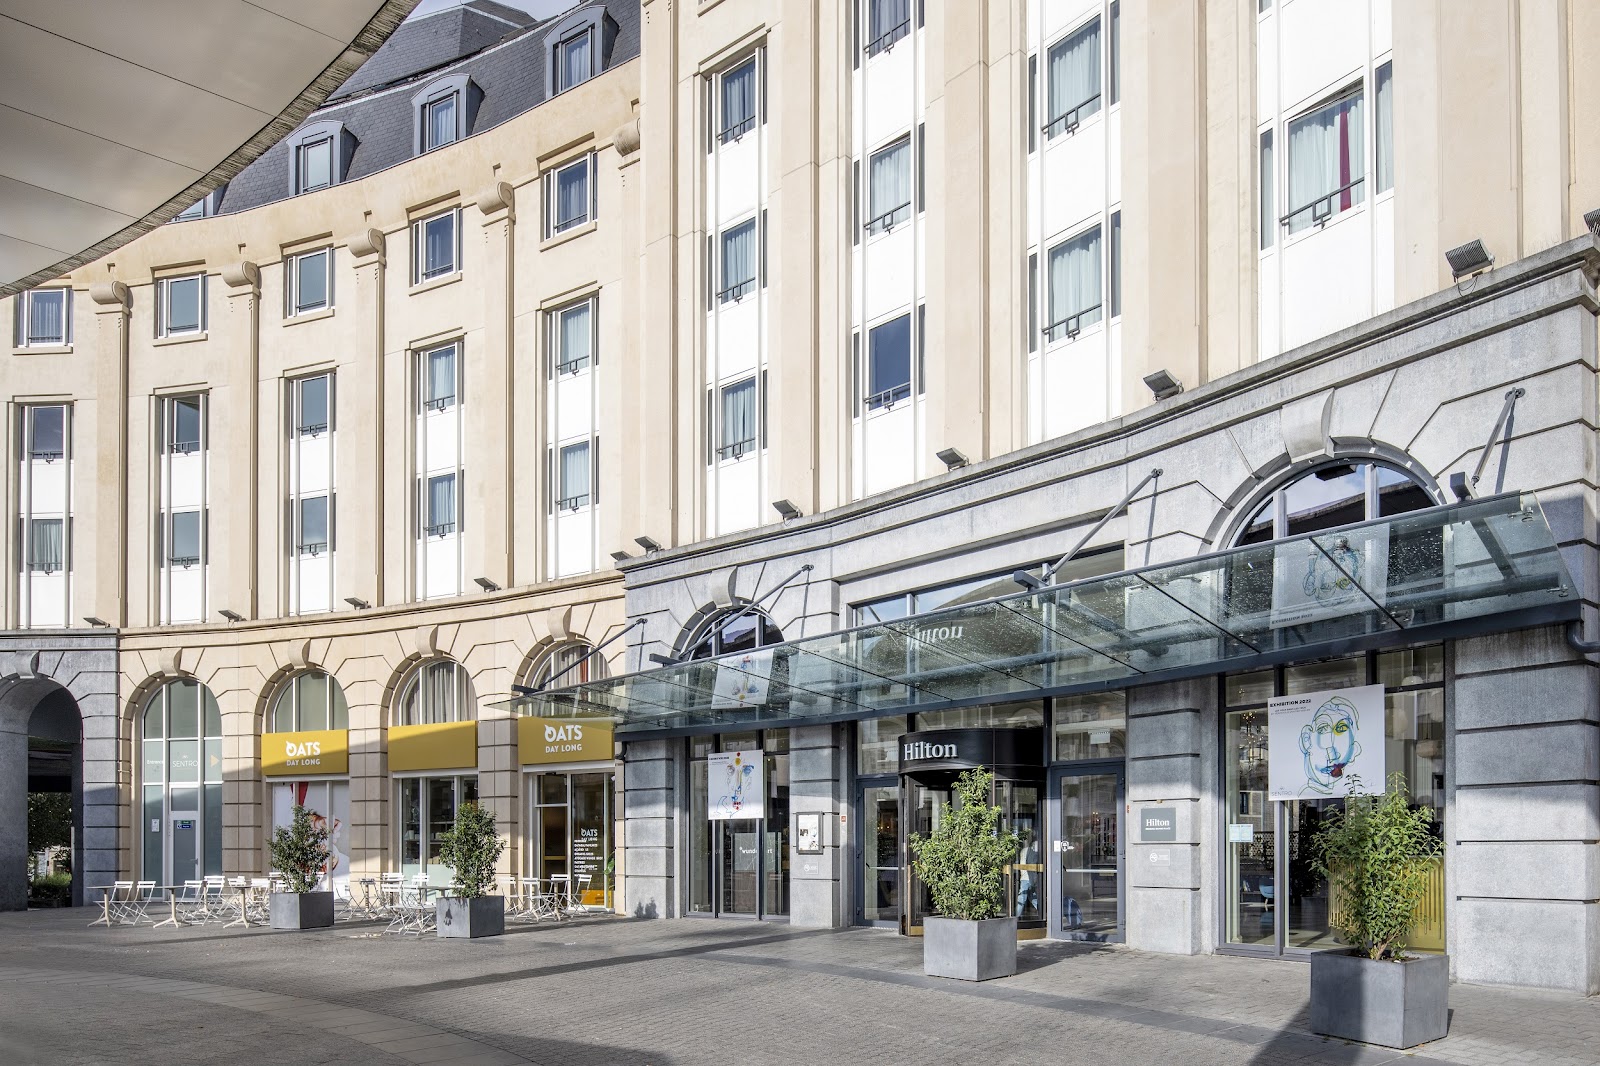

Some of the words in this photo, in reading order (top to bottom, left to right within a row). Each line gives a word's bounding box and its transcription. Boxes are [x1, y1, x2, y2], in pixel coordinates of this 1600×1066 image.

[1270, 700, 1299, 708] EXHIBITION
[544, 724, 583, 743] OATS
[285, 740, 321, 757] OATS
[545, 745, 559, 754] DAY
[561, 743, 583, 753] LONG
[903, 741, 958, 761] Hilton
[172, 760, 199, 768] SENTRO
[286, 759, 299, 767] DAY
[301, 758, 321, 766] LONG
[1146, 818, 1170, 826] Hilton
[580, 828, 598, 837] OATS
